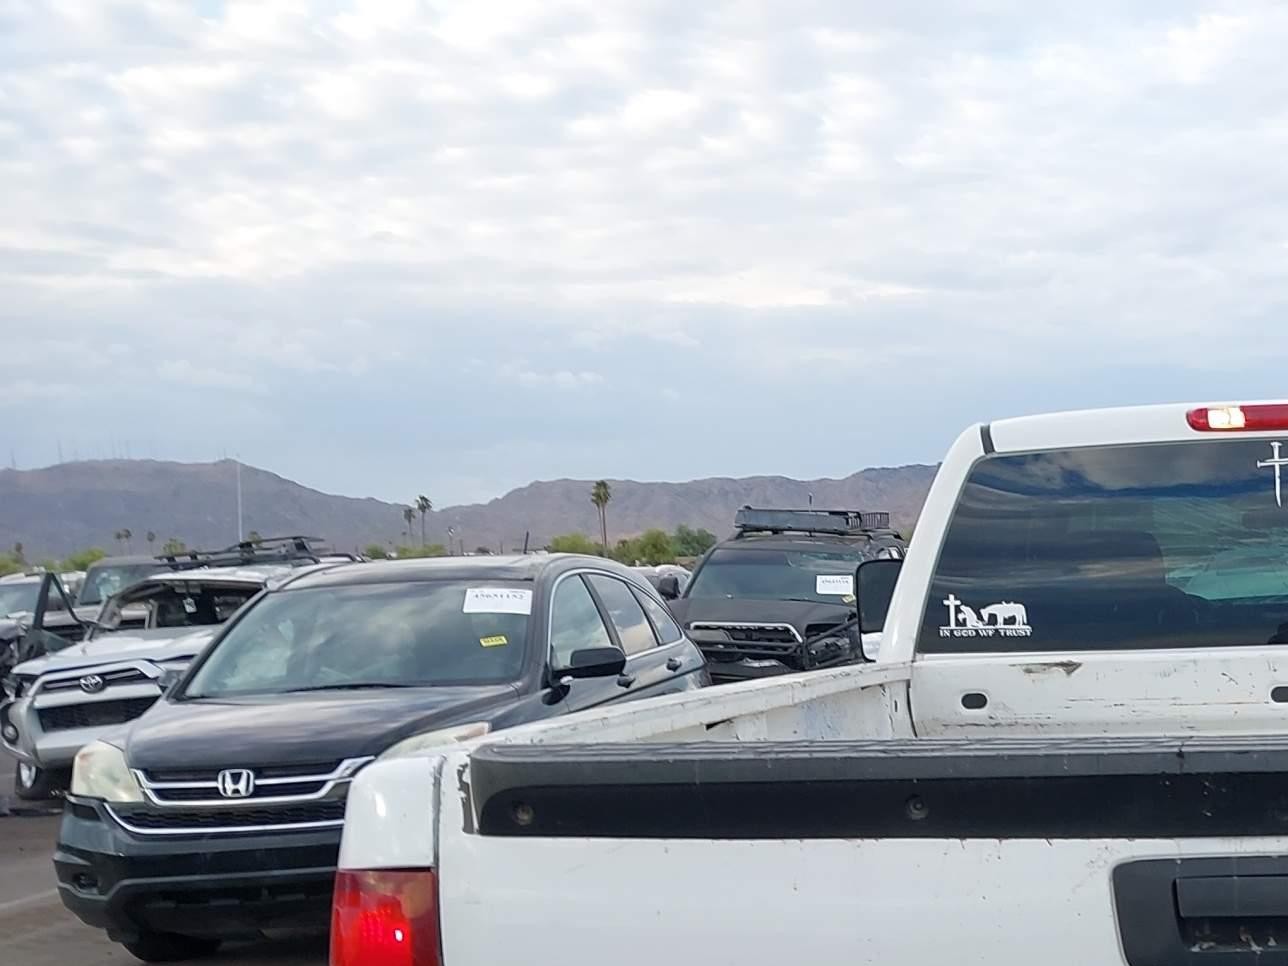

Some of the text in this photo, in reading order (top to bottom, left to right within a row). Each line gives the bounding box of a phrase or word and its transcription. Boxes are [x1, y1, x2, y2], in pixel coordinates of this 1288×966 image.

[939, 629, 951, 637] IN
[953, 629, 977, 637] GOD
[998, 629, 1032, 637] TRUST
